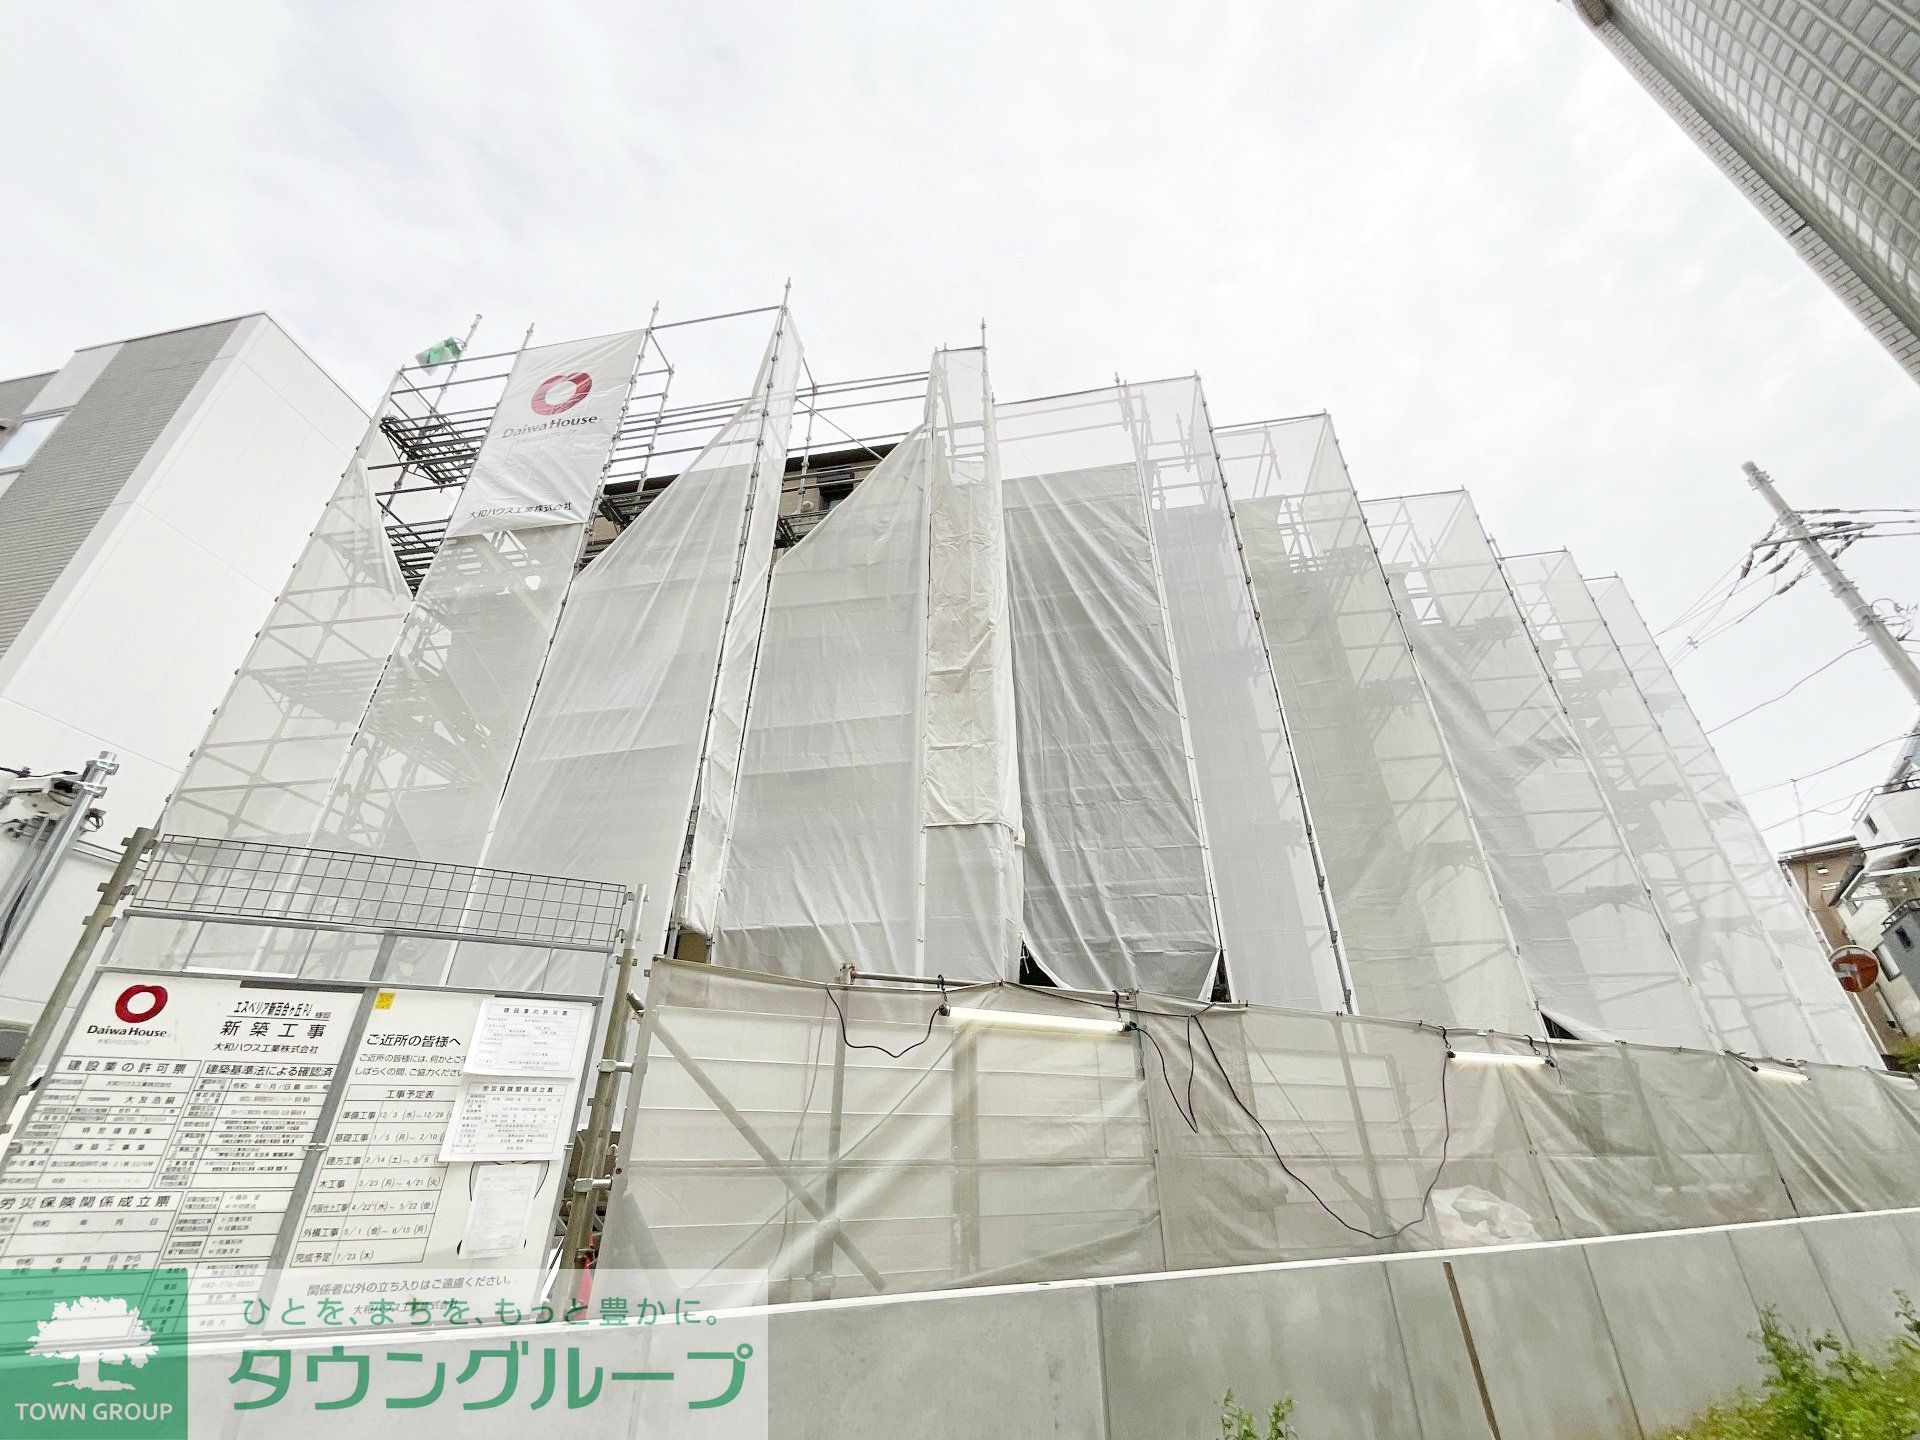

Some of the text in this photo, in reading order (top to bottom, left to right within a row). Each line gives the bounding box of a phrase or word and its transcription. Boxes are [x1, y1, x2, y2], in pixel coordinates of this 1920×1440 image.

[503, 423, 546, 438] Daiwa
[550, 416, 598, 428] House
[87, 1025, 167, 1038] Daiwa House
[219, 1020, 327, 1039] 新築工事
[367, 1034, 461, 1048] ご近所の皆様へ
[212, 1042, 319, 1055] 大和ハウス工業株式会社
[67, 1059, 188, 1075] 建設業の許可票
[205, 1063, 334, 1077] 建築基準法による確認済
[386, 1089, 435, 1099] 工事予定表
[319, 1179, 345, 1189] 木工事
[306, 1275, 512, 1296] 関係者以外の立ち入りはご遠慮ください。
